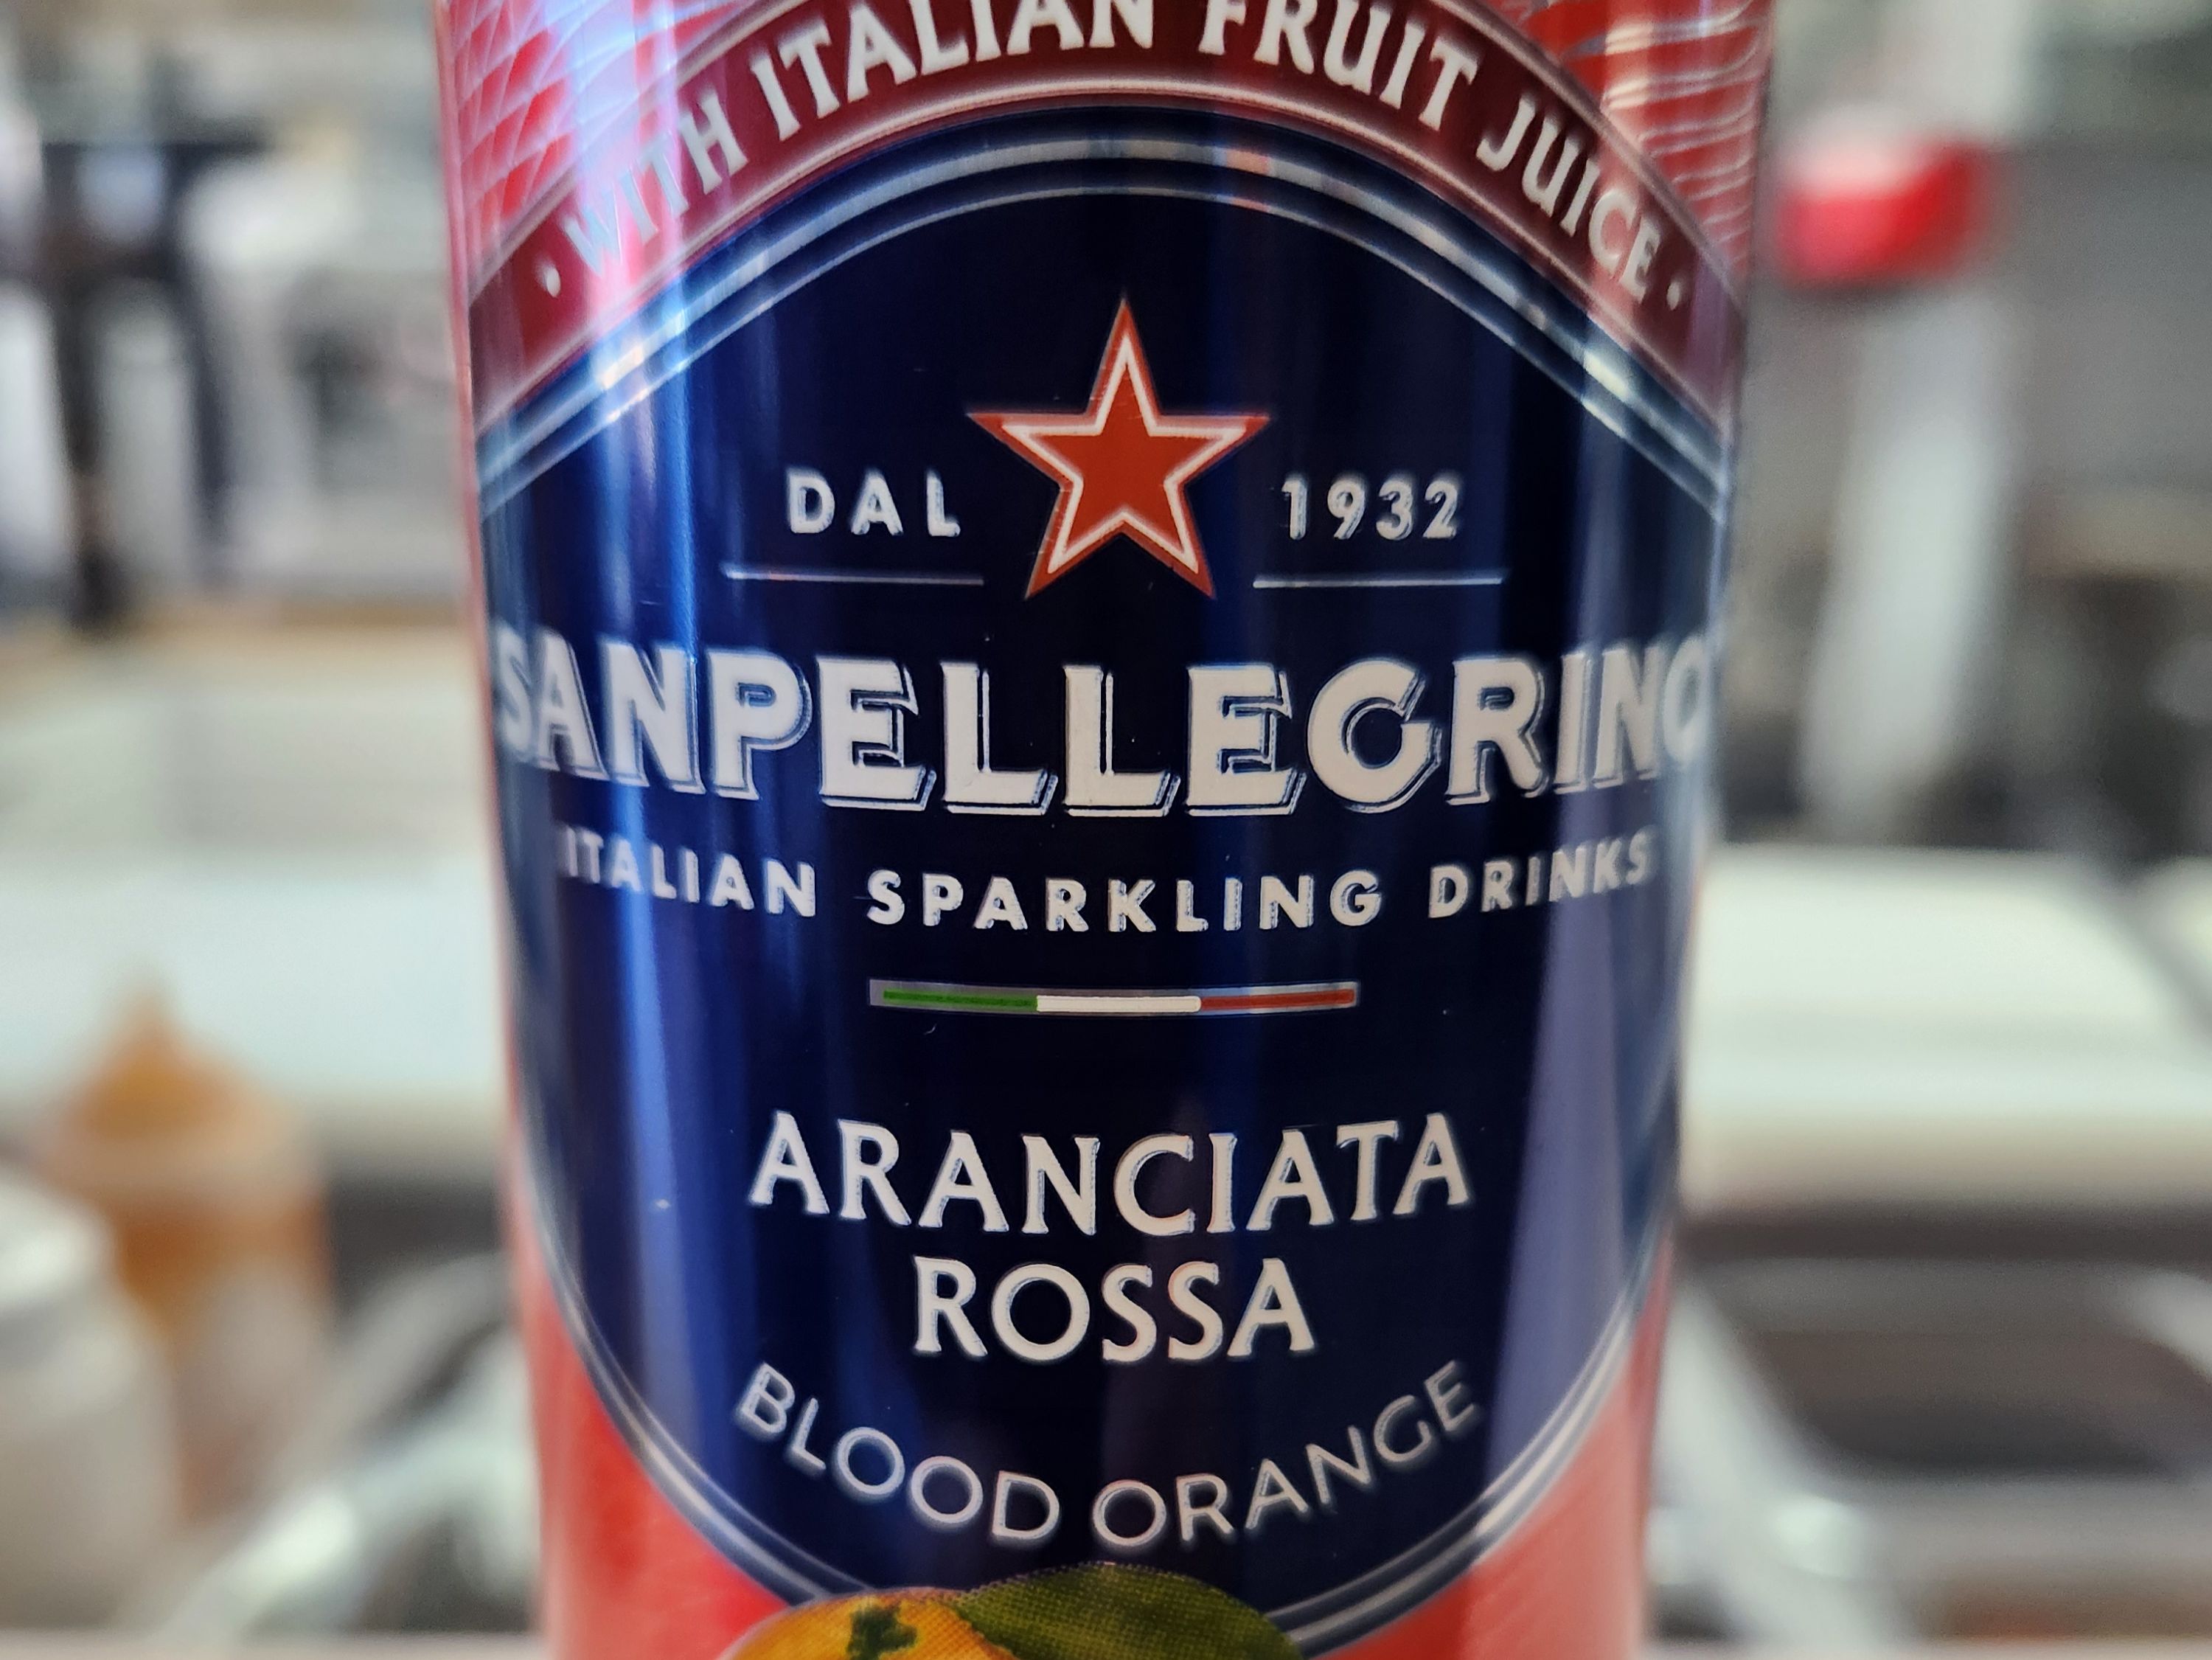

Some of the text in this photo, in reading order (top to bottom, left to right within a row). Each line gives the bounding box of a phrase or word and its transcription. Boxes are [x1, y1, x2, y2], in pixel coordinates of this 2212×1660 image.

[749, 0, 1155, 141] ITALIAN
[1197, 0, 1480, 131] FRUIT
[1476, 94, 1662, 297] JUICE
[785, 468, 1463, 541] DAL 1932
[560, 824, 1655, 934] ITALIAN SPARKLING DRINKS
[748, 1110, 1471, 1237] ARANCIATA
[911, 1255, 1317, 1363] ROSSA
[737, 1358, 1479, 1549] BLOOD ORANGE
